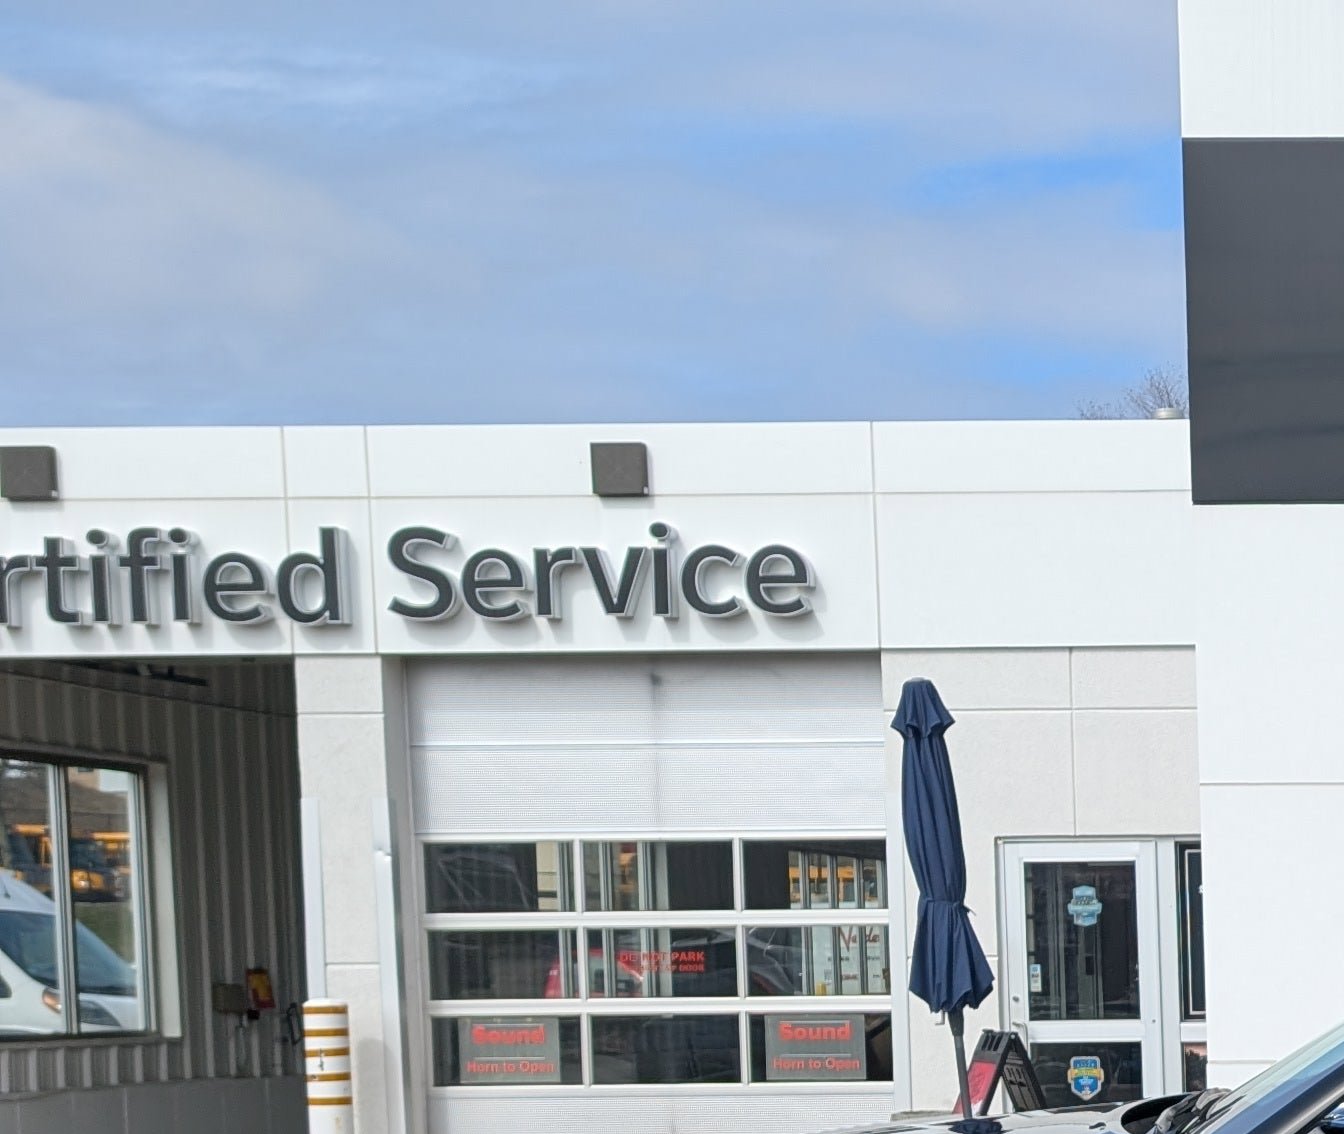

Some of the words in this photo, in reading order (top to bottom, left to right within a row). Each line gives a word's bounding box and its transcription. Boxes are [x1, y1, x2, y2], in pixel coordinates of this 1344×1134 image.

[387, 521, 814, 624] Service
[671, 951, 705, 962] PARK
[472, 1024, 545, 1045] Sound
[778, 1022, 851, 1040] Sound
[467, 1061, 499, 1073] Horn
[502, 1061, 516, 1073] to
[519, 1060, 554, 1076] Open
[773, 1057, 804, 1069] Horn
[808, 1057, 821, 1069] to
[825, 1056, 860, 1073] Open
